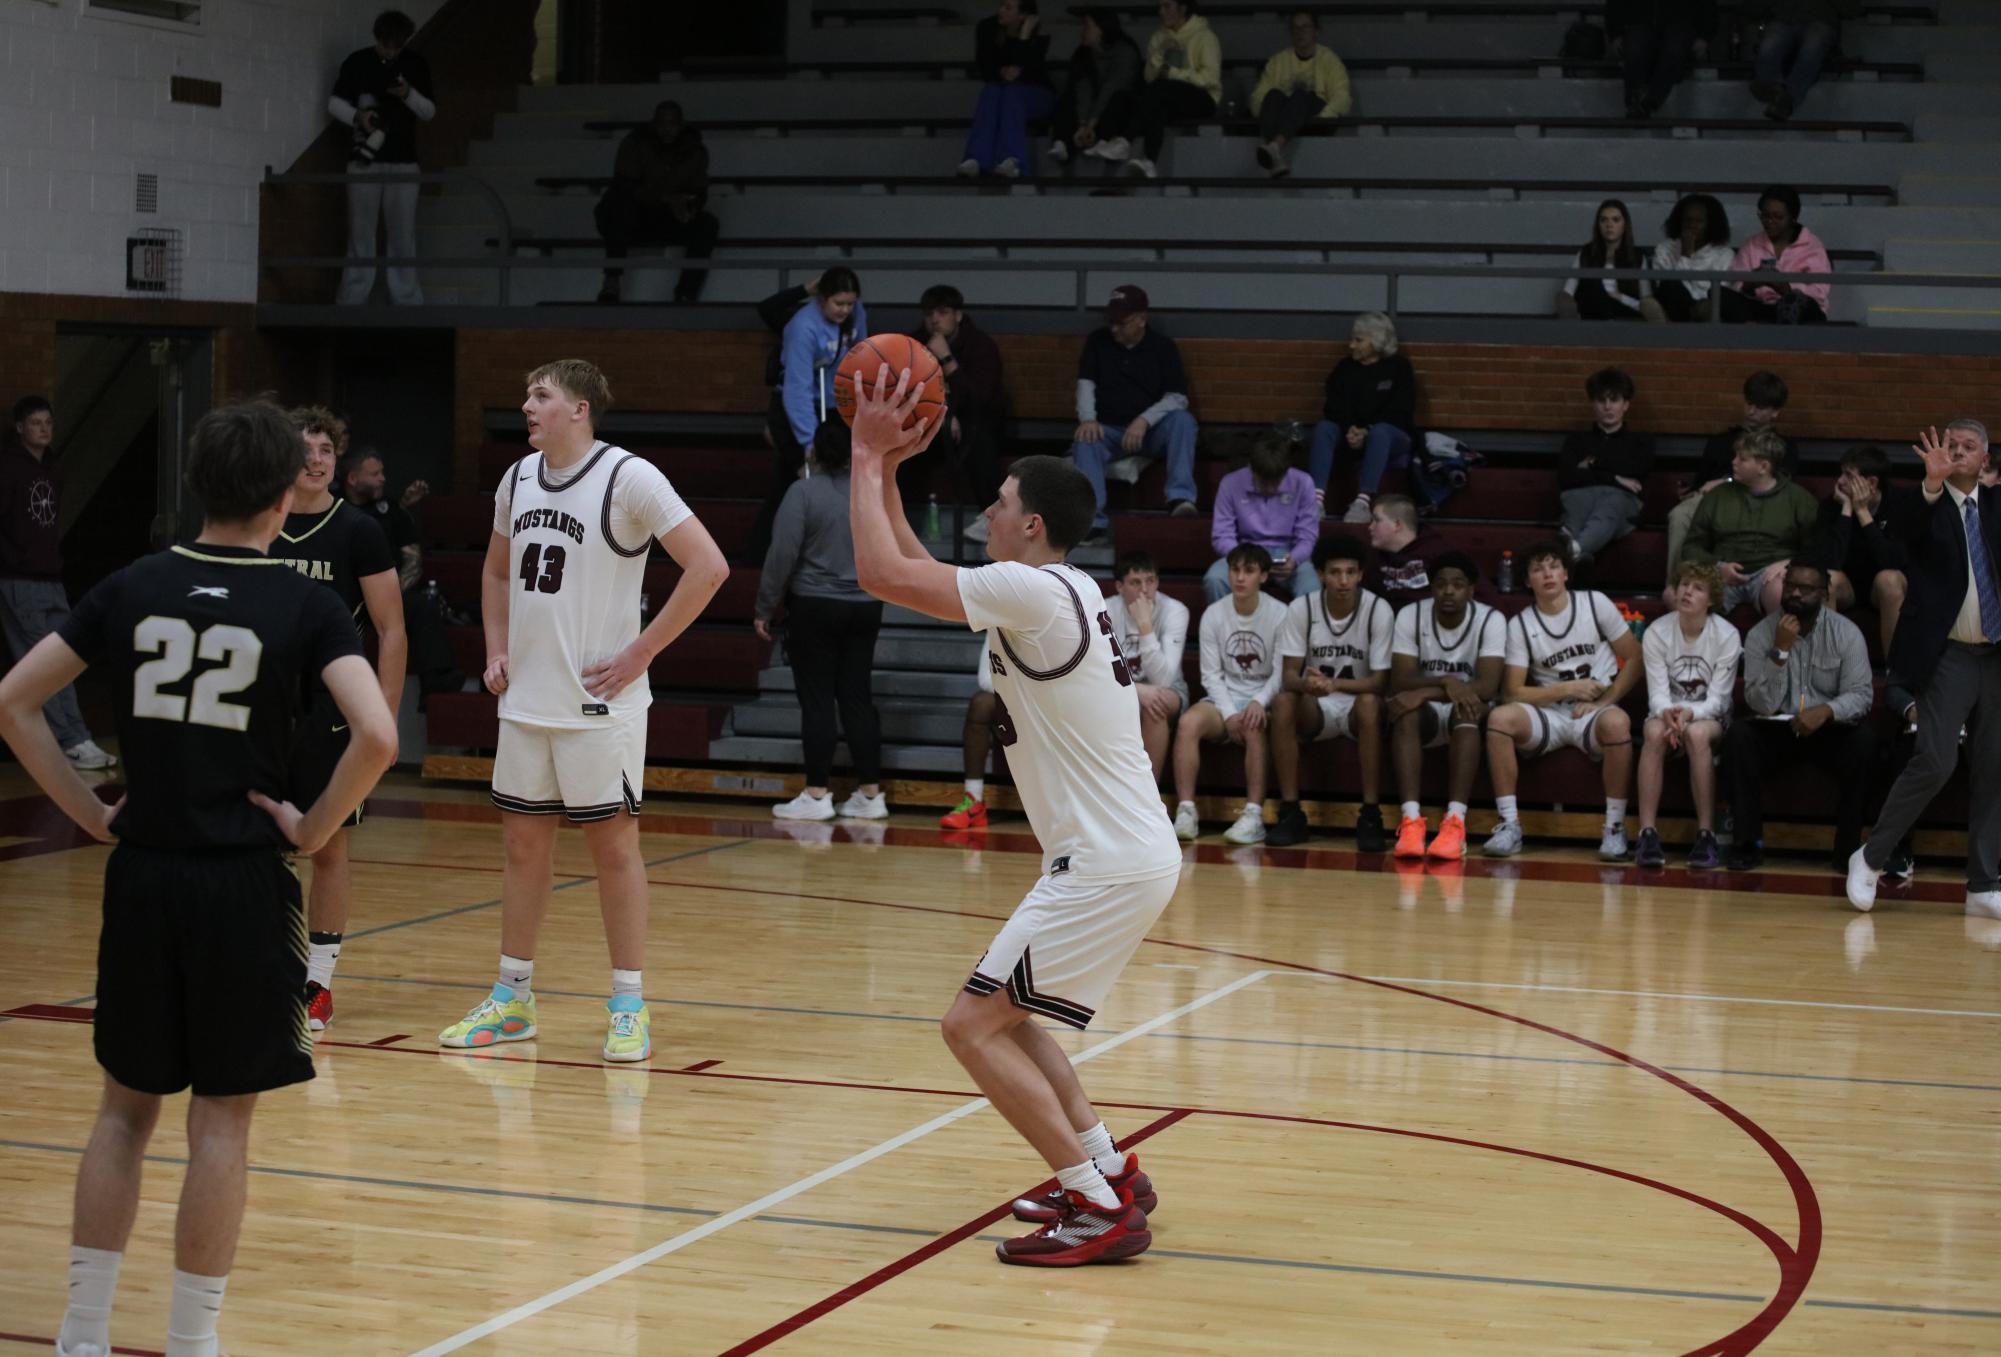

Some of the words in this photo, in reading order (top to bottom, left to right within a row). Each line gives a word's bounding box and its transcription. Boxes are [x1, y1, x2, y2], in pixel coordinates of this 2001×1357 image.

[513, 509, 584, 544] MUSTANGS
[519, 543, 566, 594] 43
[132, 615, 263, 732] 22
